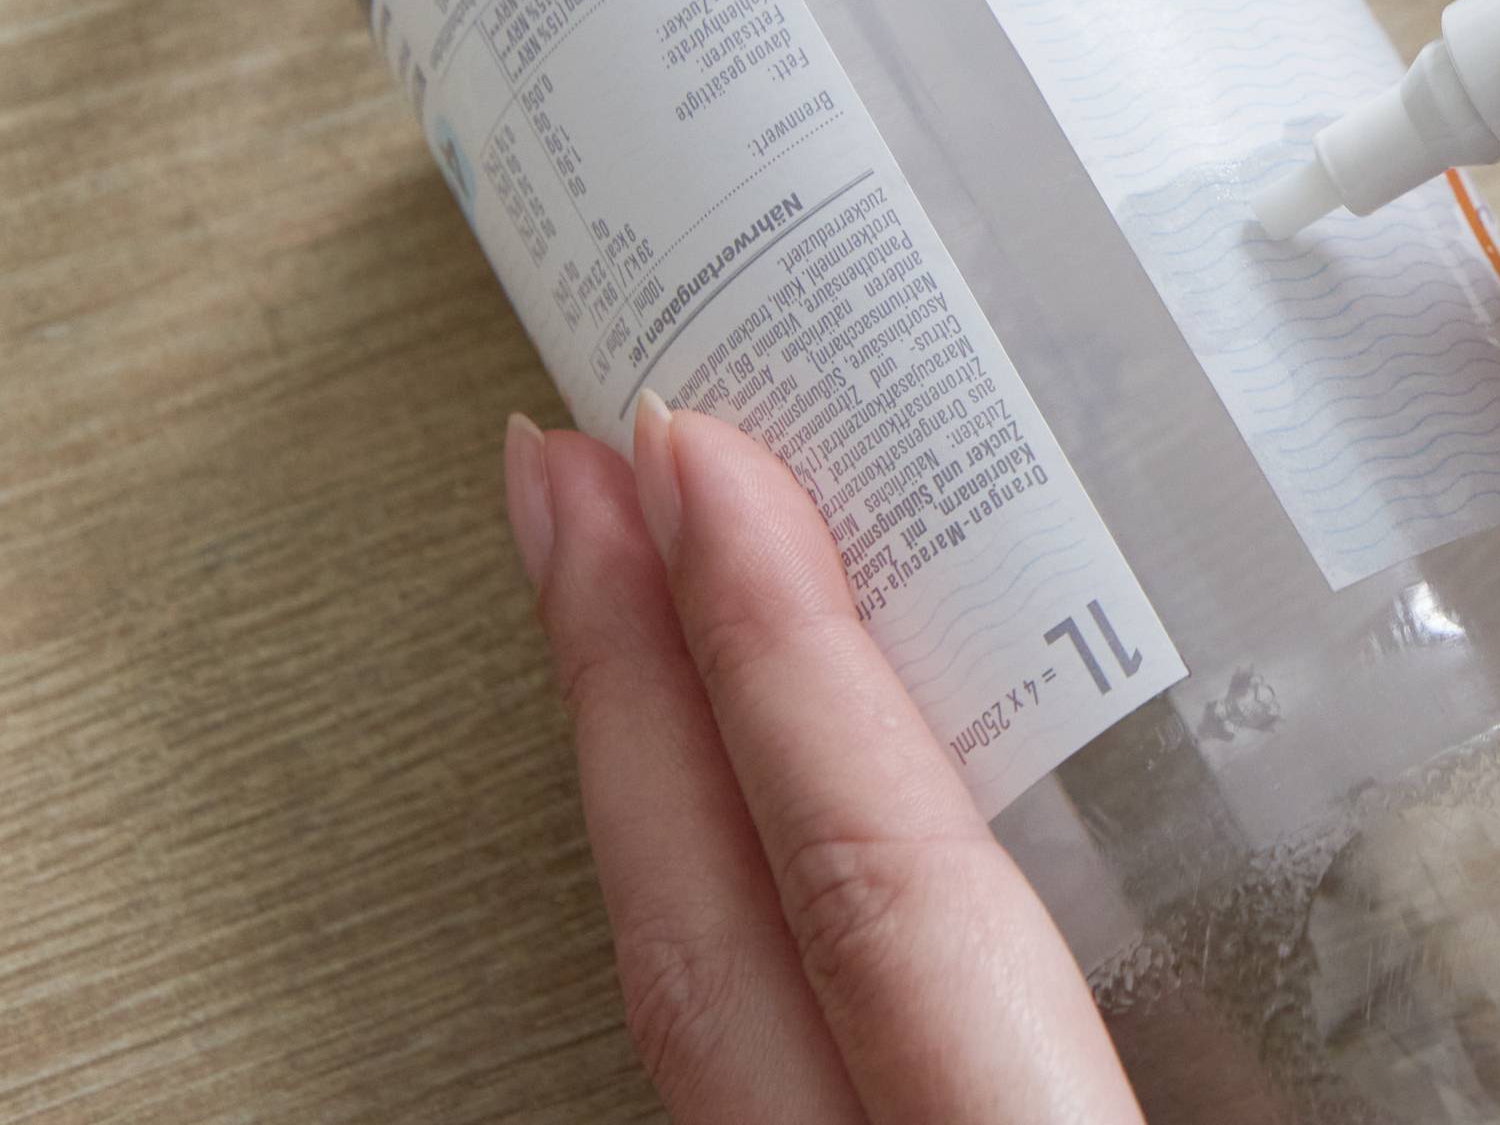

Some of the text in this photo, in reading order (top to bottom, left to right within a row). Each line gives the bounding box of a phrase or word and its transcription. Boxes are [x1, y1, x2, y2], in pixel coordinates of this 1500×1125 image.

[675, 27, 792, 121] davon gesättigte
[695, 3, 786, 73] Fettsäuren:
[767, 46, 810, 82] Fett:
[747, 90, 835, 157] Brennwert:
[603, 230, 630, 267] kcal
[623, 252, 642, 281] kJ
[635, 237, 655, 265] 39
[776, 186, 888, 275] zuckerreduziert.
[798, 229, 914, 314] Pantothensäure,
[801, 208, 902, 287] brotkernmehl.
[628, 192, 804, 369] Nährwertangaben je:
[632, 274, 665, 319] 100ml
[767, 275, 807, 313] Kühl,
[706, 342, 732, 376] und
[725, 303, 774, 351] trocken
[727, 250, 923, 412] anderen natürlichen Aromen,
[737, 271, 938, 436] Natriumsaccharin), natürliches
[751, 311, 803, 358] Vitamin
[678, 362, 711, 408] dunkel
[760, 291, 949, 452] Ascorbinsäure, Süßungsmittel
[773, 313, 963, 467] Citrus- und Zitronenextrak
[816, 335, 975, 462] Maracujasaftkonzentrat
[817, 377, 997, 527] aus Orangensaftkonzentrat
[827, 355, 987, 484] Zitronensaftkonzentrat
[945, 397, 1012, 449] Zutaten:
[837, 419, 1025, 569] Zucker und Süßungsmitte
[850, 442, 1037, 592] Kalorienarm, mit Zusatz
[863, 447, 941, 514] Natürliches
[853, 464, 1049, 623] Orangen-Maracuja-Erfr
[949, 598, 1144, 766] 1L = 4 x 250ml
